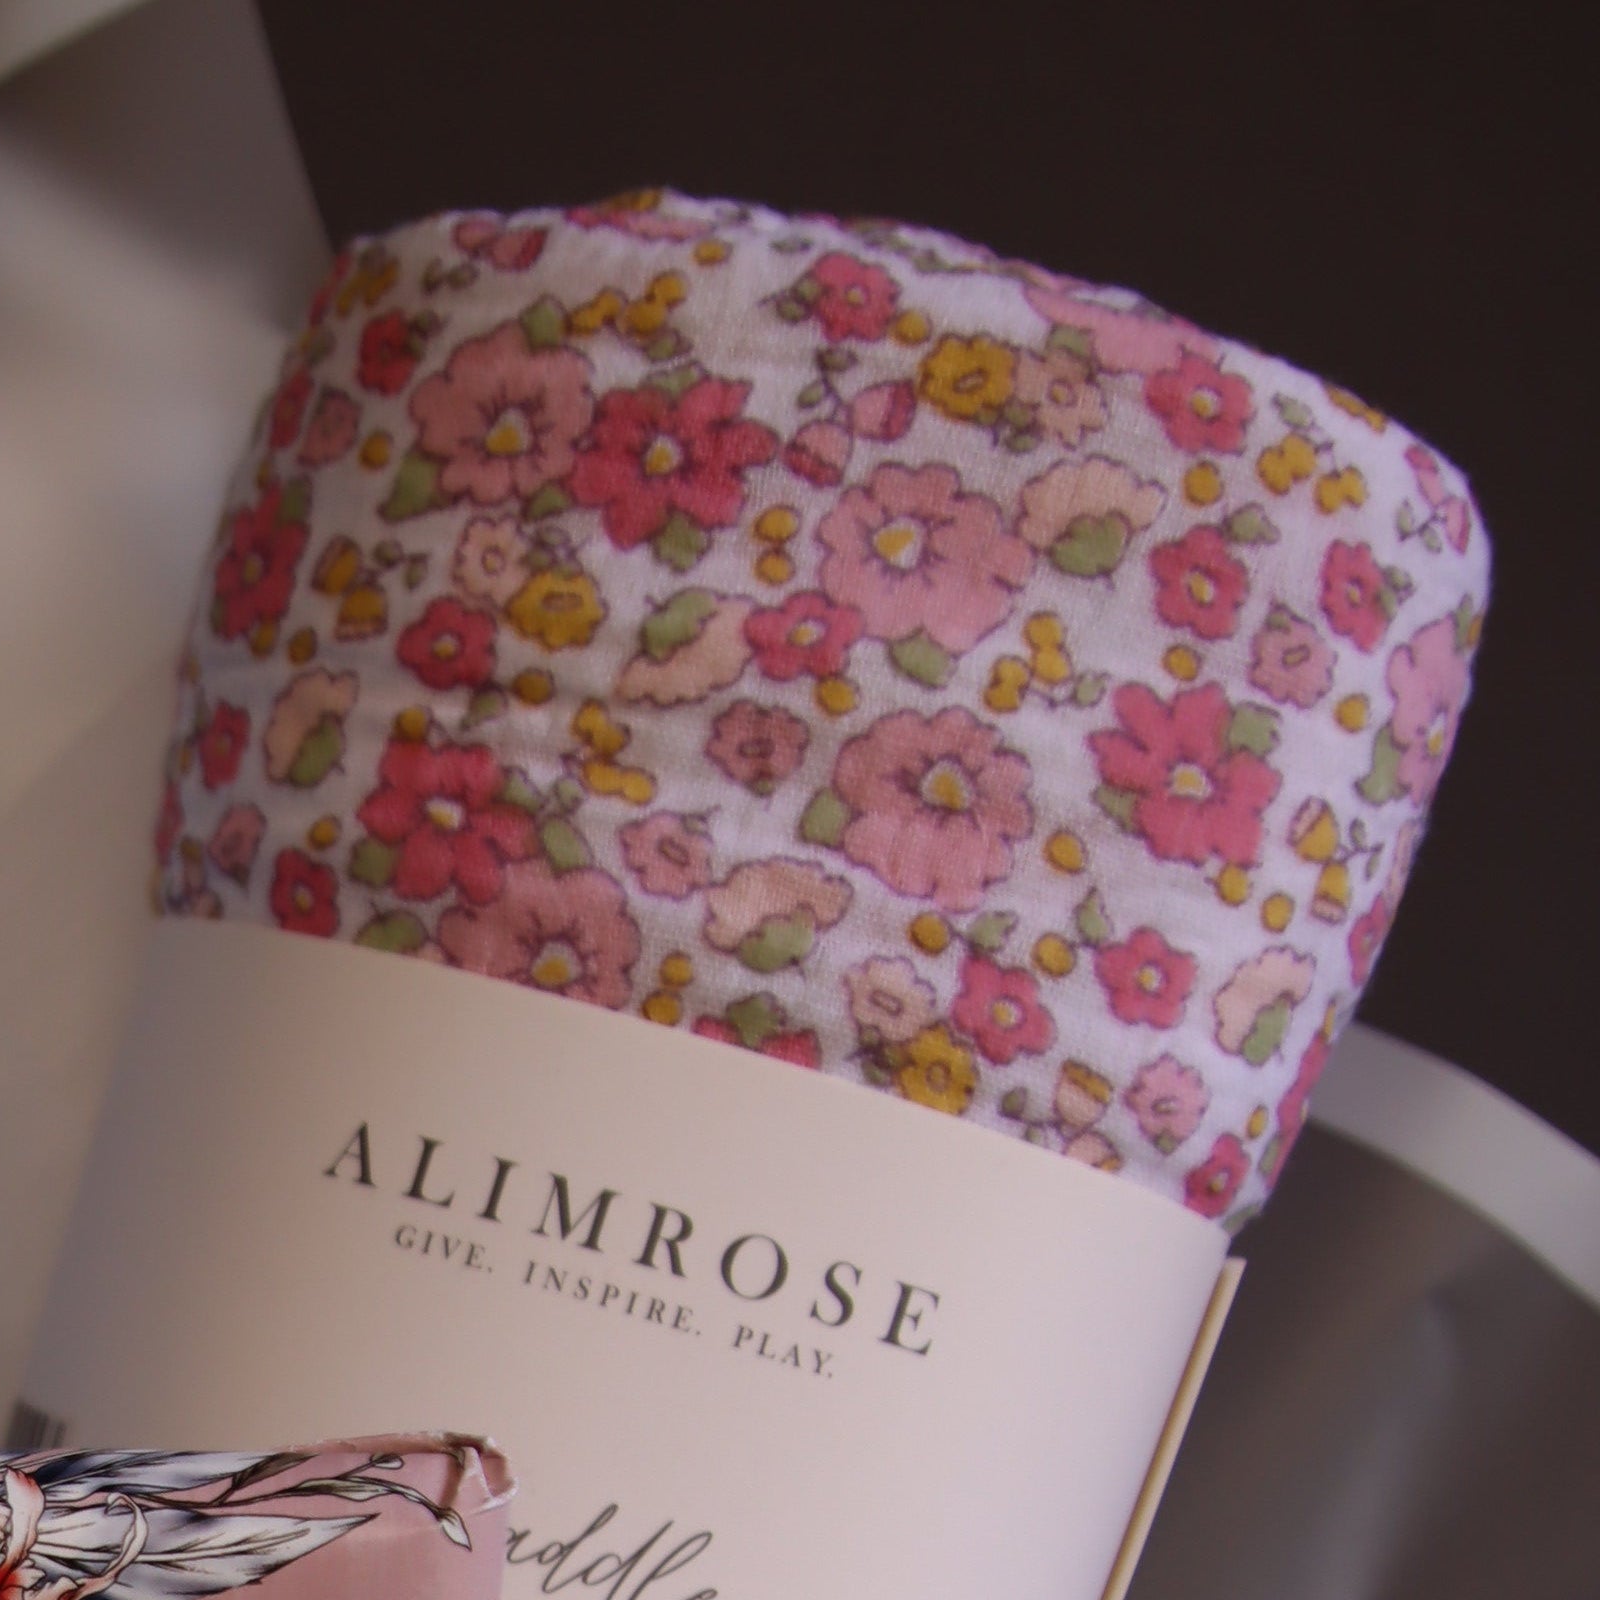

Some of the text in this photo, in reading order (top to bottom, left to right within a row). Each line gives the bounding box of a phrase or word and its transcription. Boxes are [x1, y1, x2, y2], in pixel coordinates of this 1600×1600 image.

[323, 1121, 941, 1356] ALIMROSE
[394, 1224, 834, 1379] GIVE. INSPIRE. PLAY.
